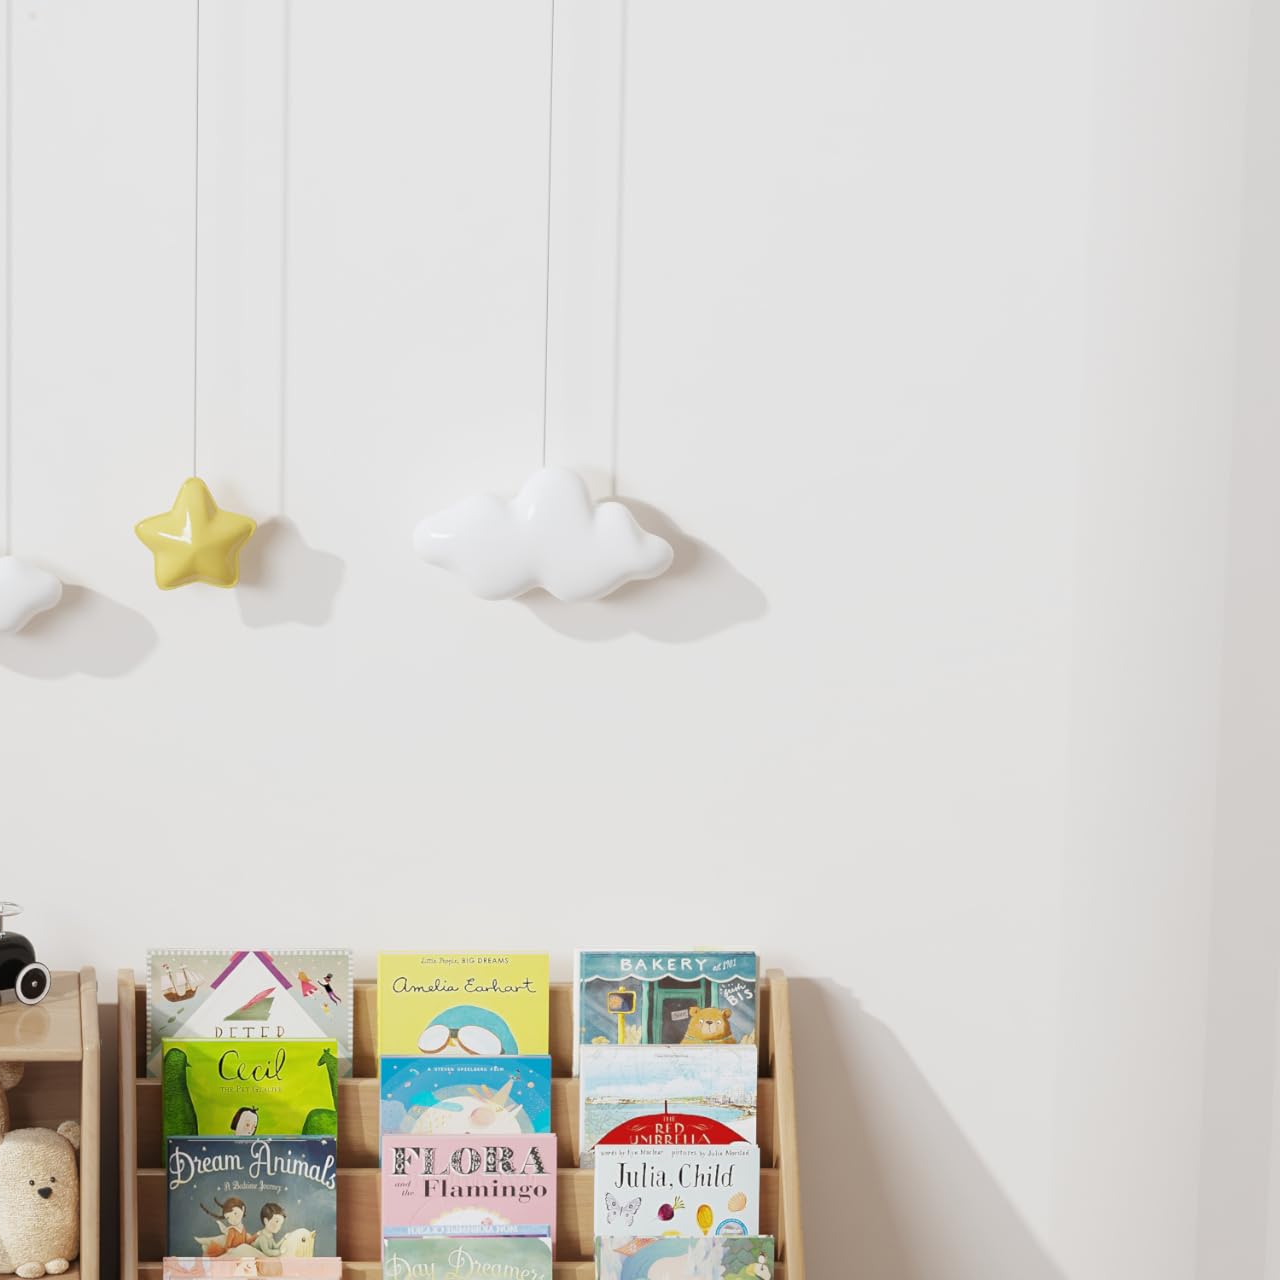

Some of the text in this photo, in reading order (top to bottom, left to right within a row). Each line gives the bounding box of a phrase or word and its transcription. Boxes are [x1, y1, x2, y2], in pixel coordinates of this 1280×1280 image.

[620, 958, 709, 971] BAKERY
[392, 976, 537, 993] Amelia Earhart
[218, 1048, 286, 1081] Cecil
[655, 1123, 685, 1134] RED
[169, 1138, 336, 1190] Dream Animals
[391, 1146, 551, 1176] FLORA
[678, 1163, 736, 1188] Child
[424, 1180, 548, 1203] Flamingo
